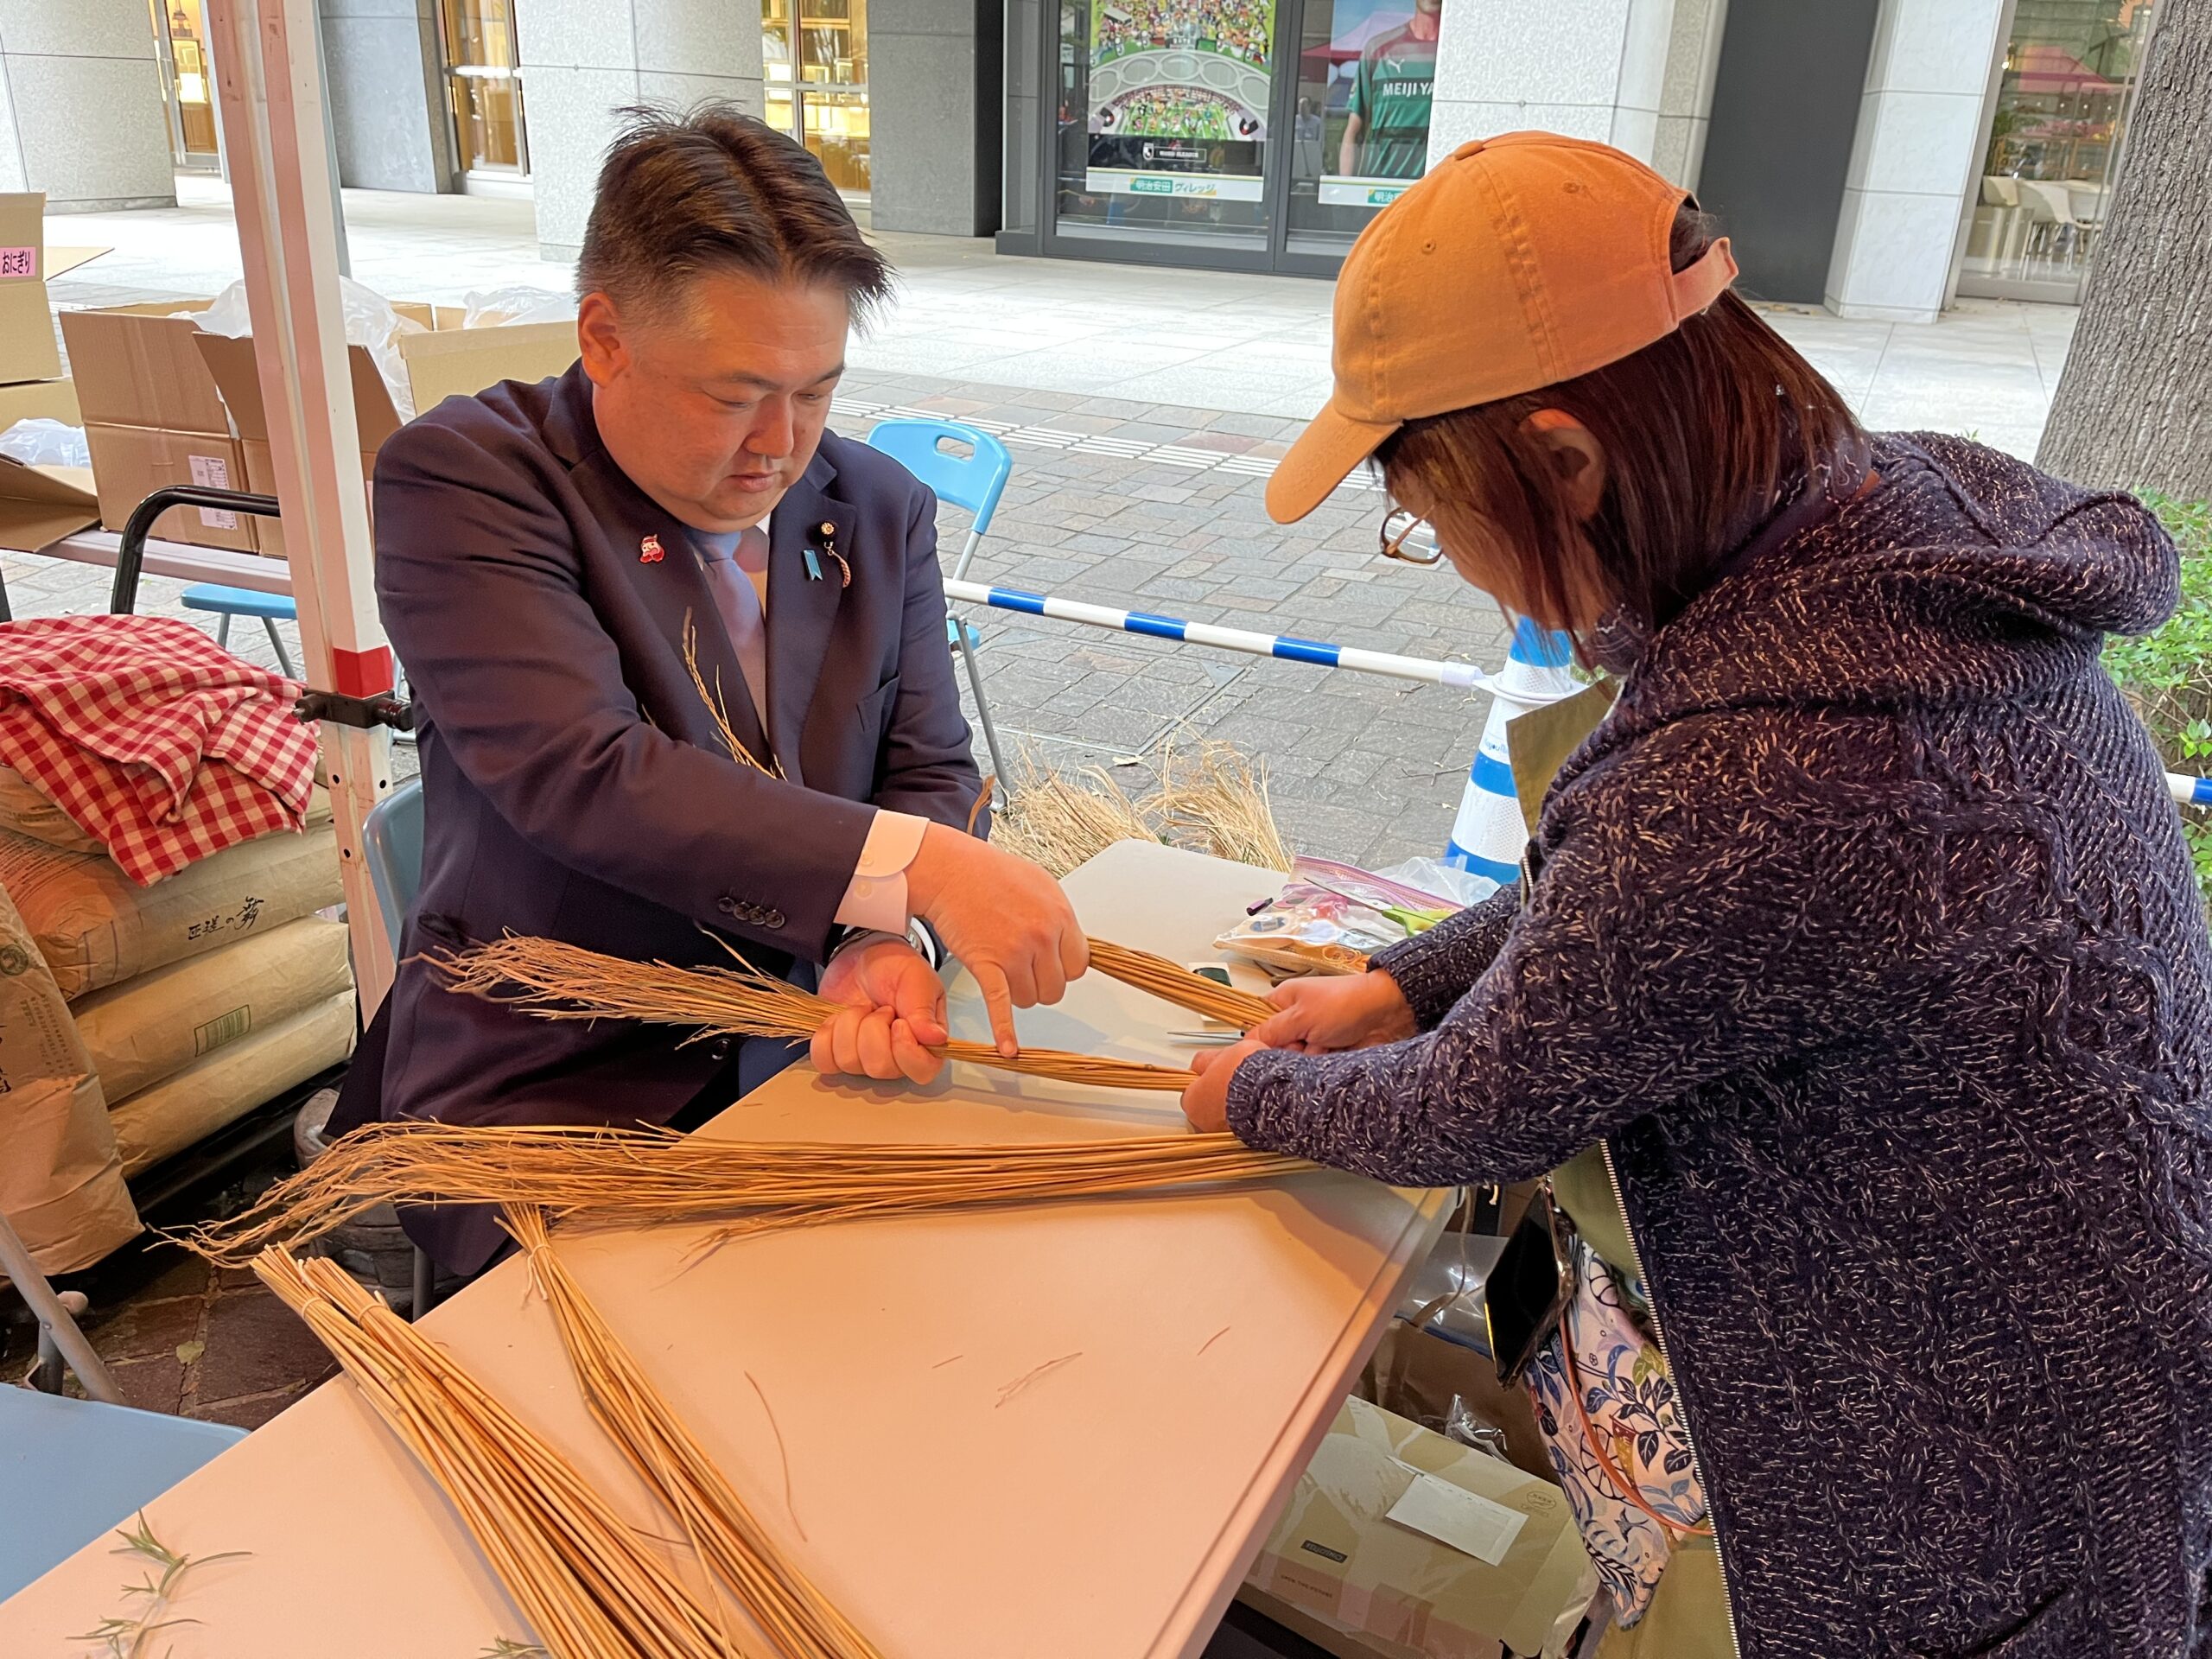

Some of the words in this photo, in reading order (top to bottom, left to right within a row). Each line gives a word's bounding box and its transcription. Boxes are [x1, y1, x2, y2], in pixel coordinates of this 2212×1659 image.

[1382, 81, 1417, 97] MEIJI
[1374, 190, 1397, 203] 明治
[2, 250, 30, 275] おにぎり
